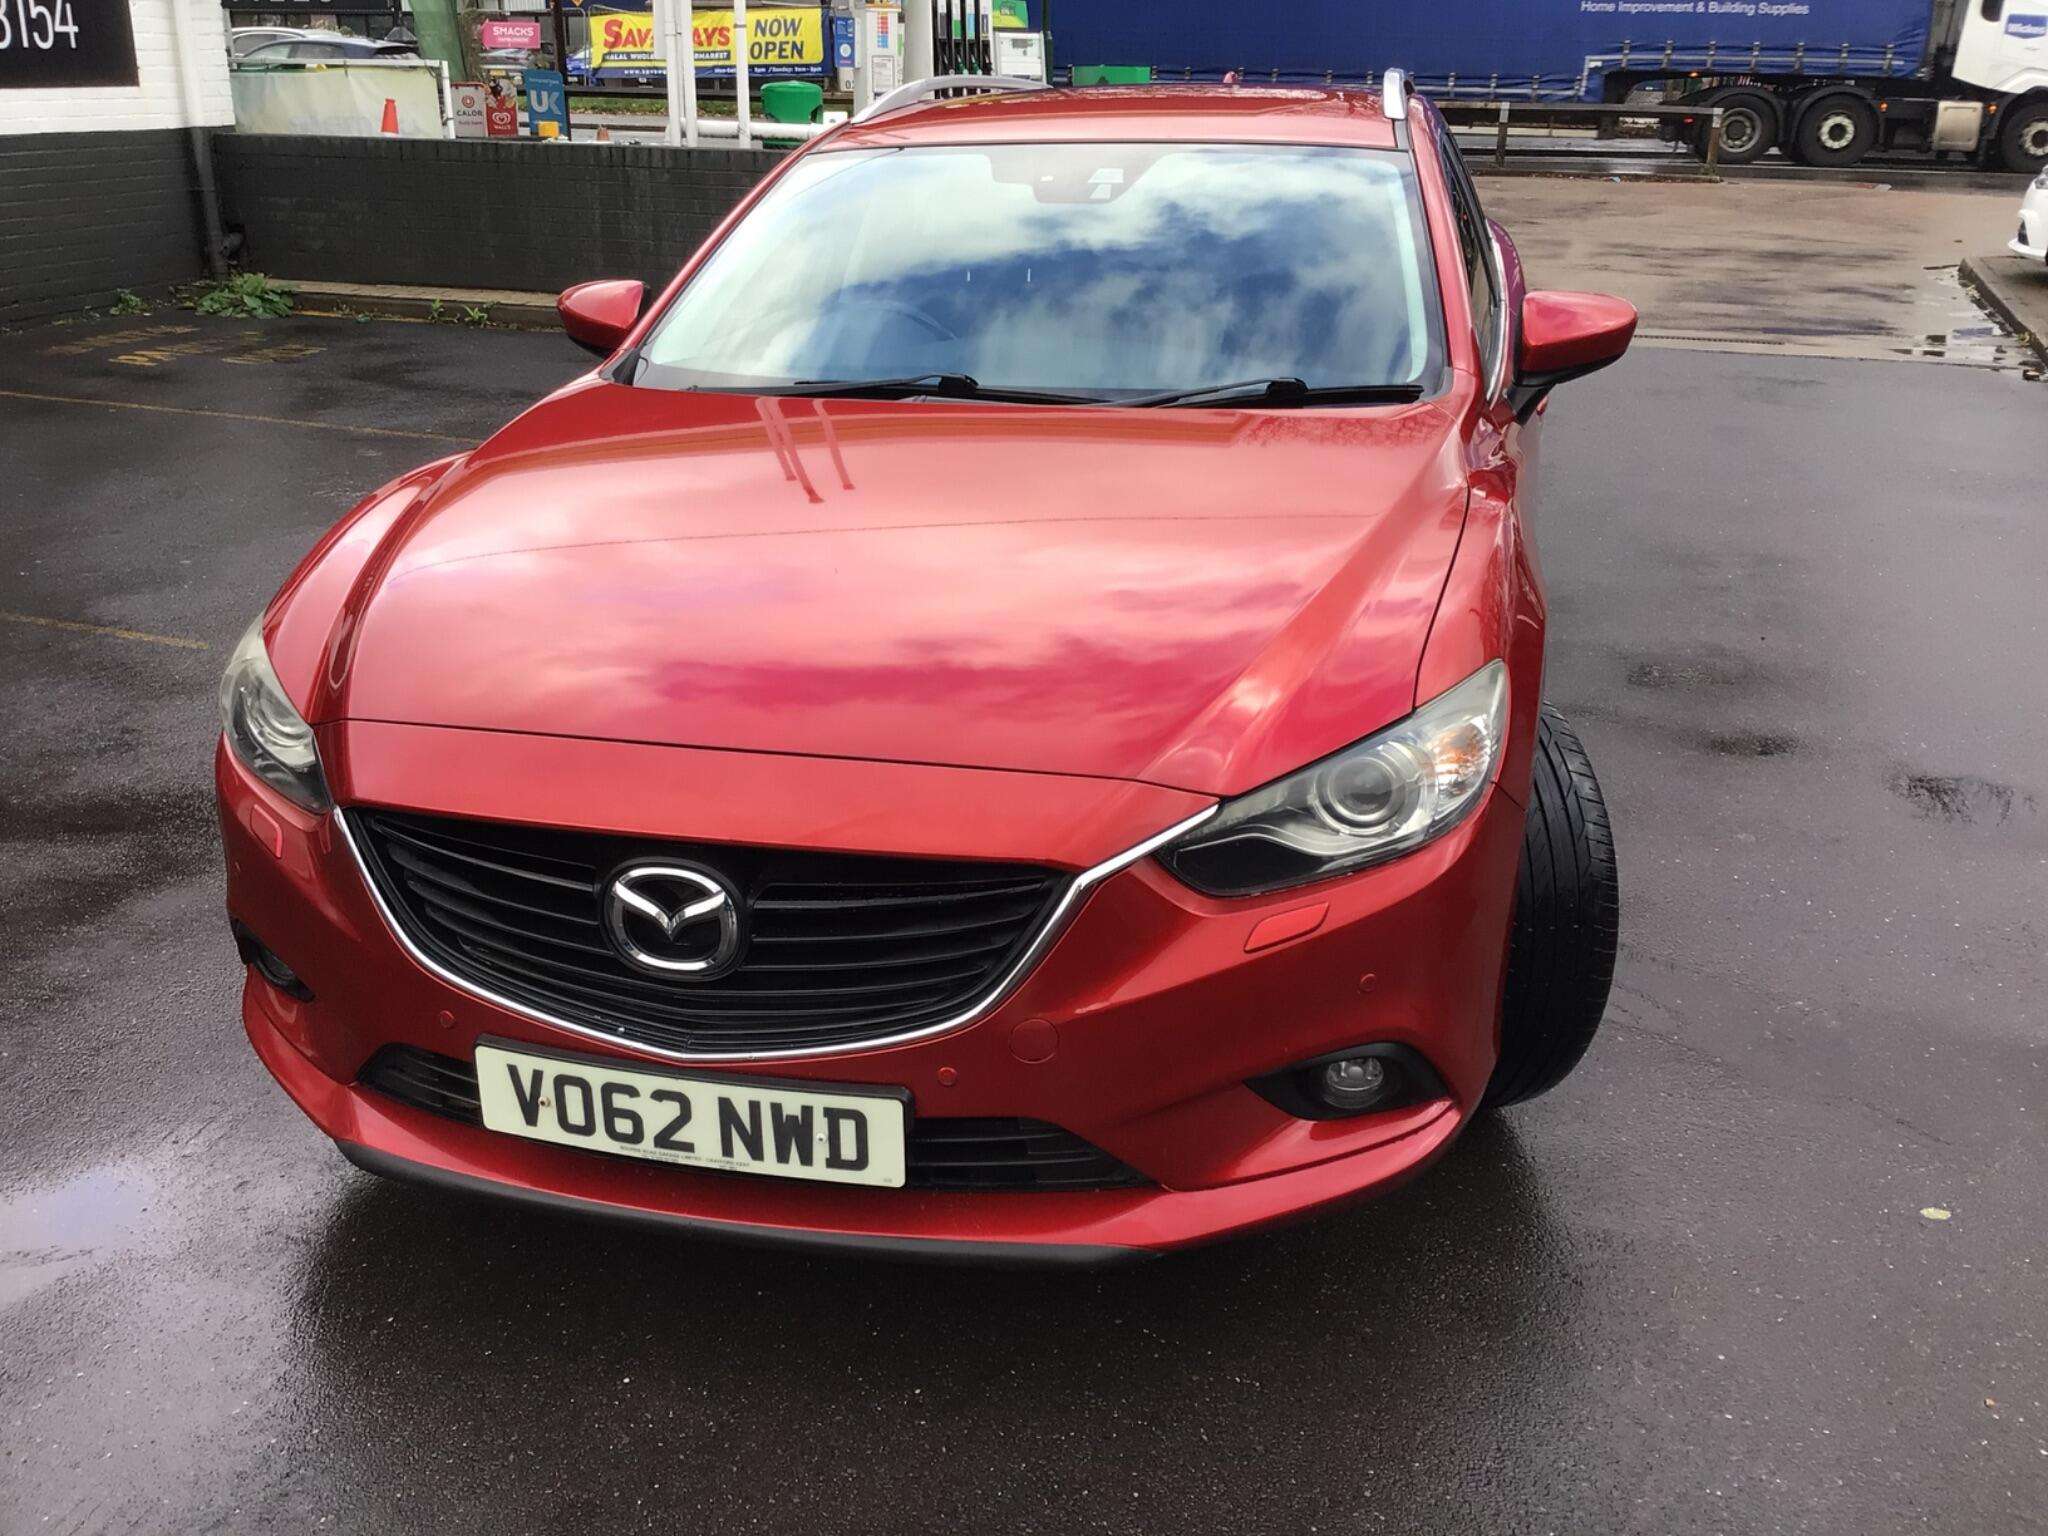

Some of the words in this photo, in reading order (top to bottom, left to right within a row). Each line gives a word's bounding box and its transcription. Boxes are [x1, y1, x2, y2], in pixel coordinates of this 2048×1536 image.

[1580, 1, 1616, 12] Home
[1618, 1, 1694, 14] Improvement
[1695, 2, 1705, 12] &
[1708, 1, 1755, 16] Building
[1757, 2, 1810, 16] Supplies
[492, 26, 534, 36] SMACKS
[754, 18, 803, 37] NOW
[750, 41, 804, 59] OPEN
[530, 90, 562, 115] UK
[506, 1063, 695, 1154] VO62
[717, 1096, 870, 1172] NWD
